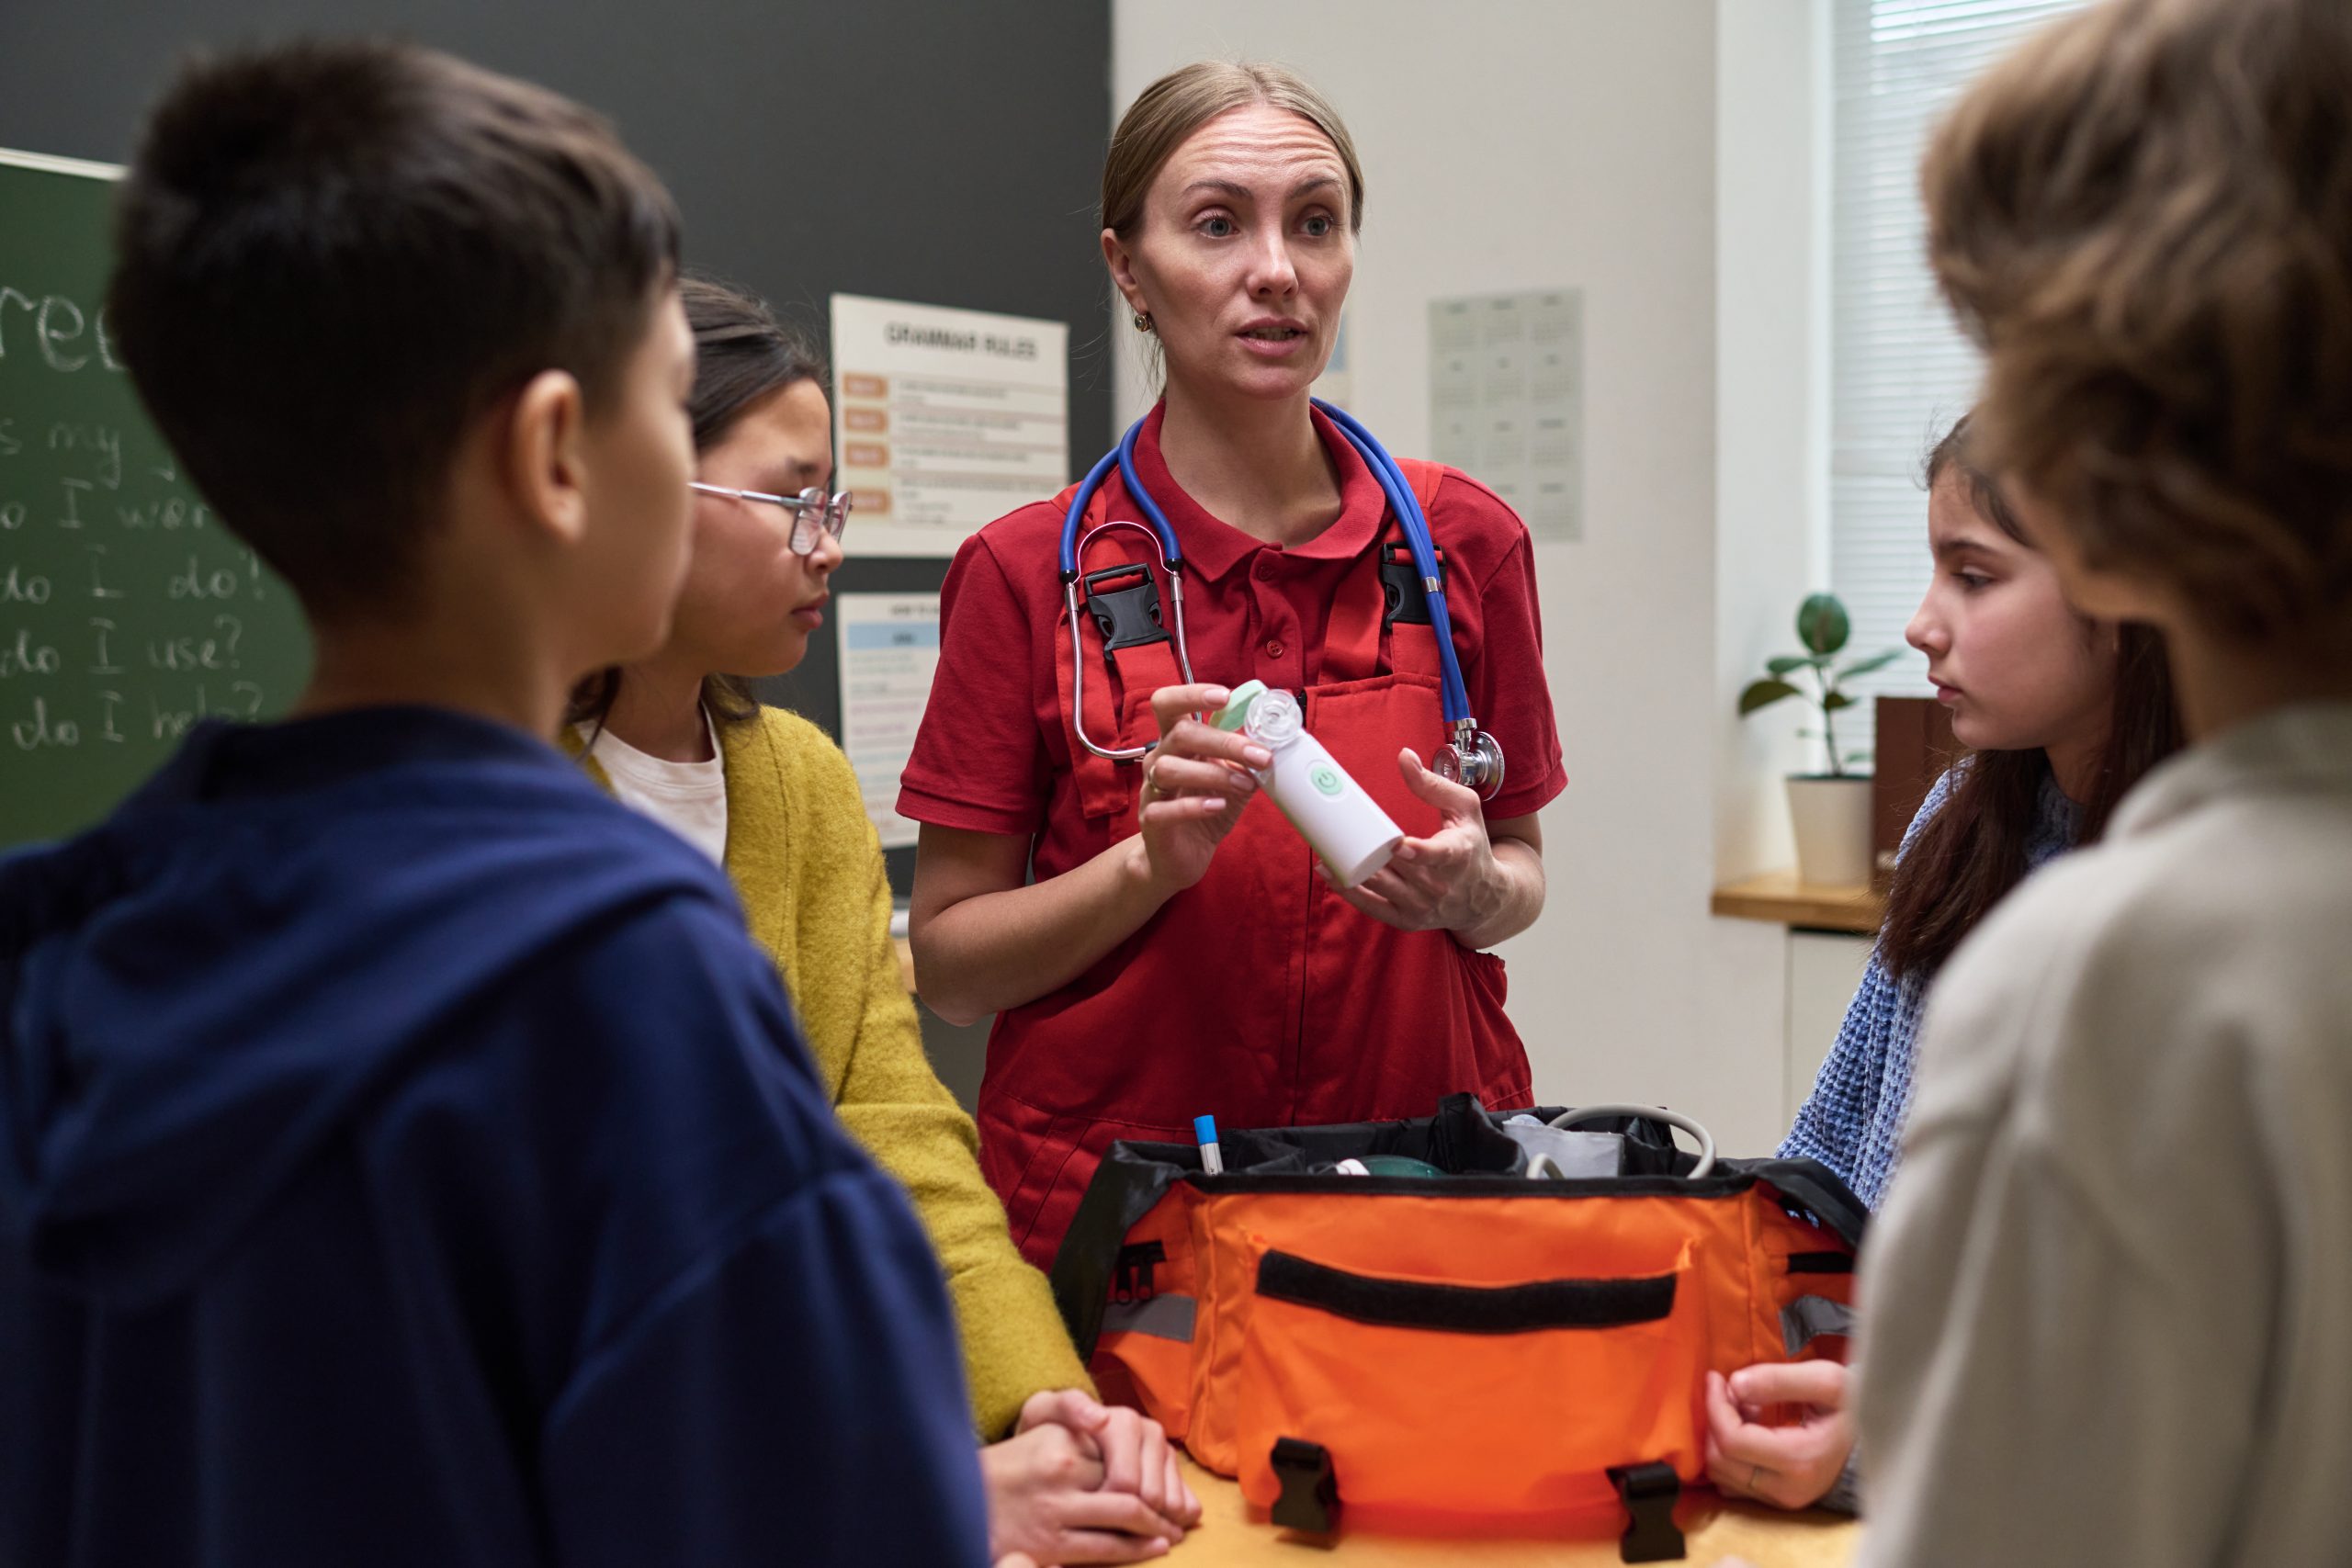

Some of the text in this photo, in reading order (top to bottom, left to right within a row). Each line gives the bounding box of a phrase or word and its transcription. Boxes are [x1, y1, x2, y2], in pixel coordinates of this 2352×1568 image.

[88, 616, 125, 675] I
[147, 613, 243, 671] use?
[12, 695, 79, 750] do
[97, 689, 125, 743] I
